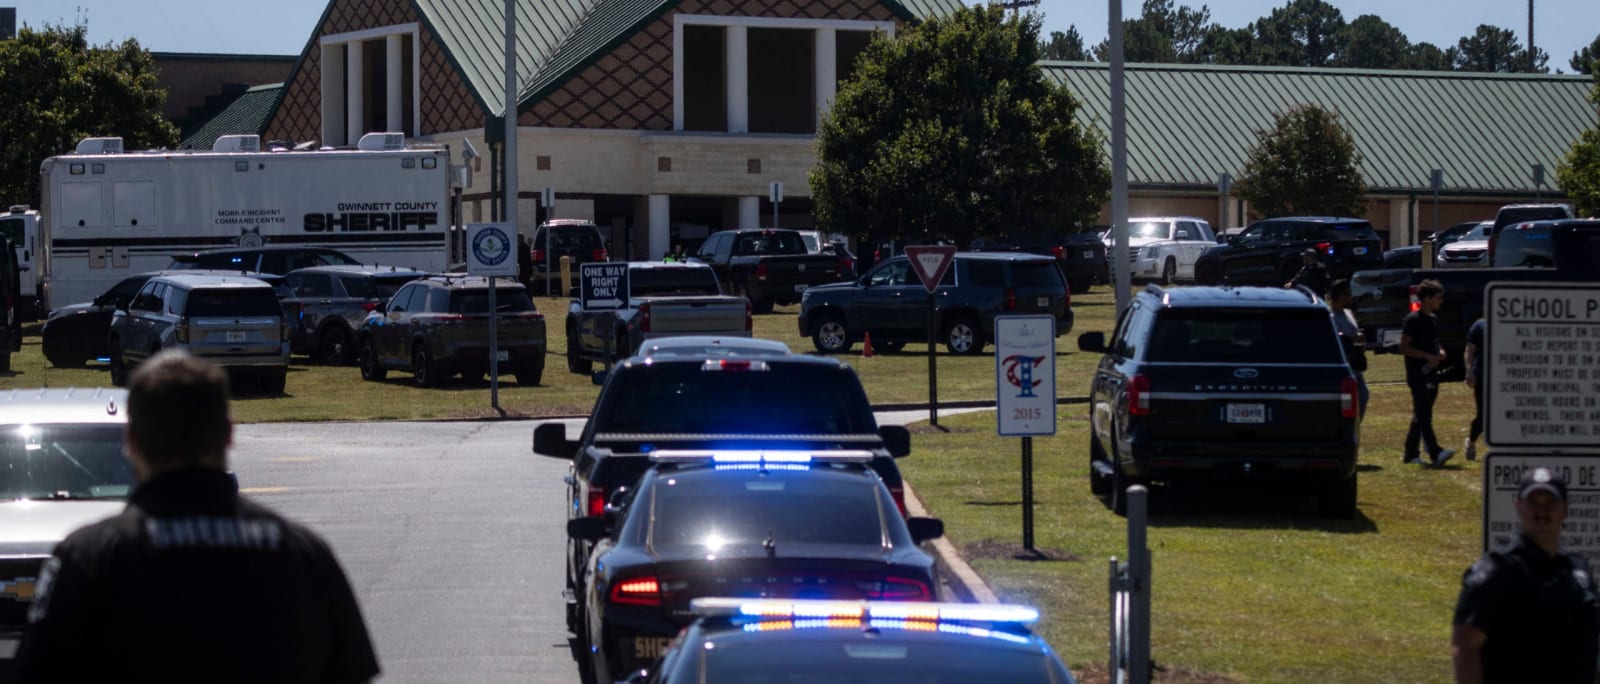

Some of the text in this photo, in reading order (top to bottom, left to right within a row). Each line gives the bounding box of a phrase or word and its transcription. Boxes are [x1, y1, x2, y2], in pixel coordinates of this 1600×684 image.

[338, 201, 438, 211] GWINNETT COUNTY
[217, 208, 281, 217] MOBILE INCIDENT
[255, 216, 286, 224] CENTER
[303, 212, 438, 232] SHERIFF
[584, 265, 626, 277] ONE WAY
[591, 277, 619, 287] RIGHT
[593, 287, 617, 297] ONLY
[1497, 297, 1600, 319] SCHOOL P
[1515, 327, 1531, 337] ALL
[1536, 327, 1572, 337] VISITORS
[1575, 327, 1587, 337] ON
[1521, 340, 1543, 351] MUST
[1547, 340, 1577, 351] REPORT
[1581, 341, 1591, 351] TO
[1499, 354, 1548, 364] PERMISSION
[1552, 354, 1562, 364] TO
[1505, 367, 1547, 378] PROPERTY
[1552, 368, 1574, 379] MUST
[1499, 382, 1531, 393] SCHOOL
[1514, 396, 1548, 407] SCHOOL
[1552, 396, 1580, 407] HOURS
[1013, 408, 1041, 420] 2015
[1559, 410, 1585, 421] THERE
[1519, 424, 1565, 435] VIOLATORS
[1569, 425, 1588, 435] WILL
[1579, 466, 1596, 486] DE
[634, 636, 674, 660] SHE
